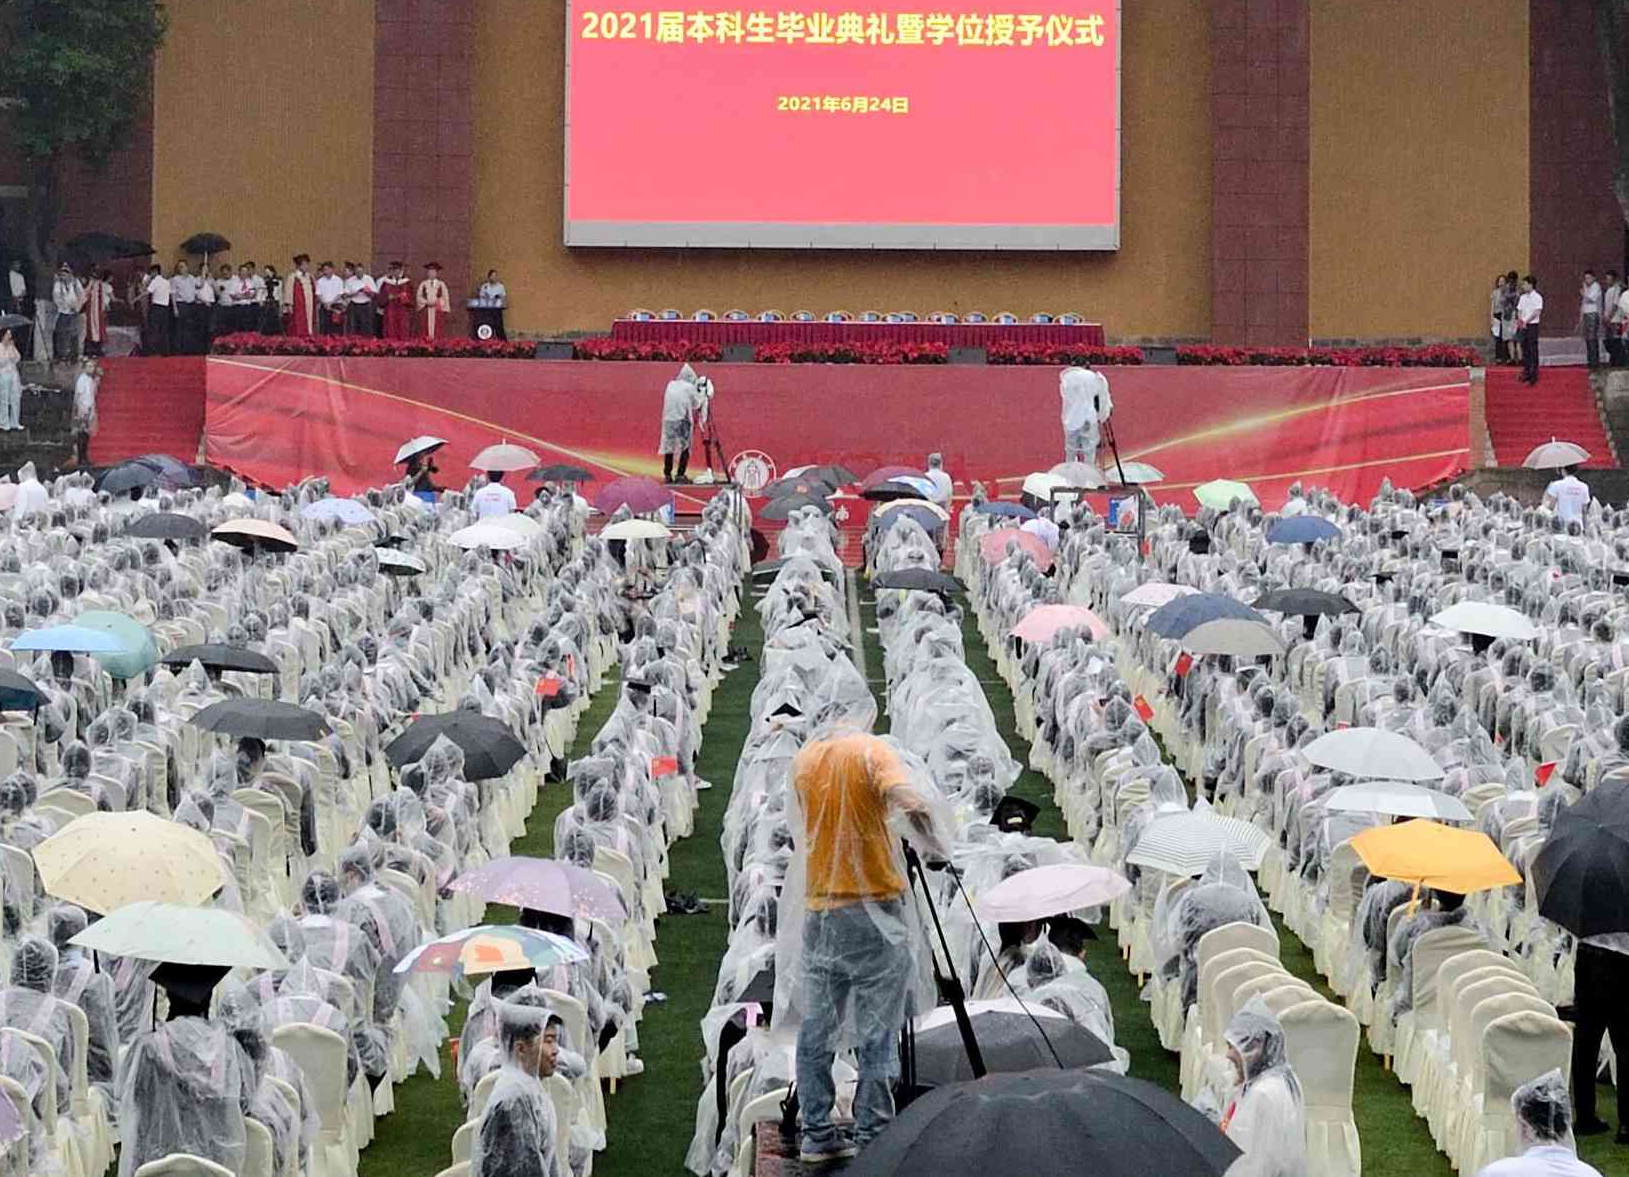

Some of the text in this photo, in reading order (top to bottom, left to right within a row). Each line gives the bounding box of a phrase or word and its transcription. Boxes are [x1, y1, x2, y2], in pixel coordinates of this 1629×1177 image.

[582, 10, 1105, 47] 2021届本科生毕业典礼暨学位授予仪式
[777, 95, 909, 114] 2021年6月24日
